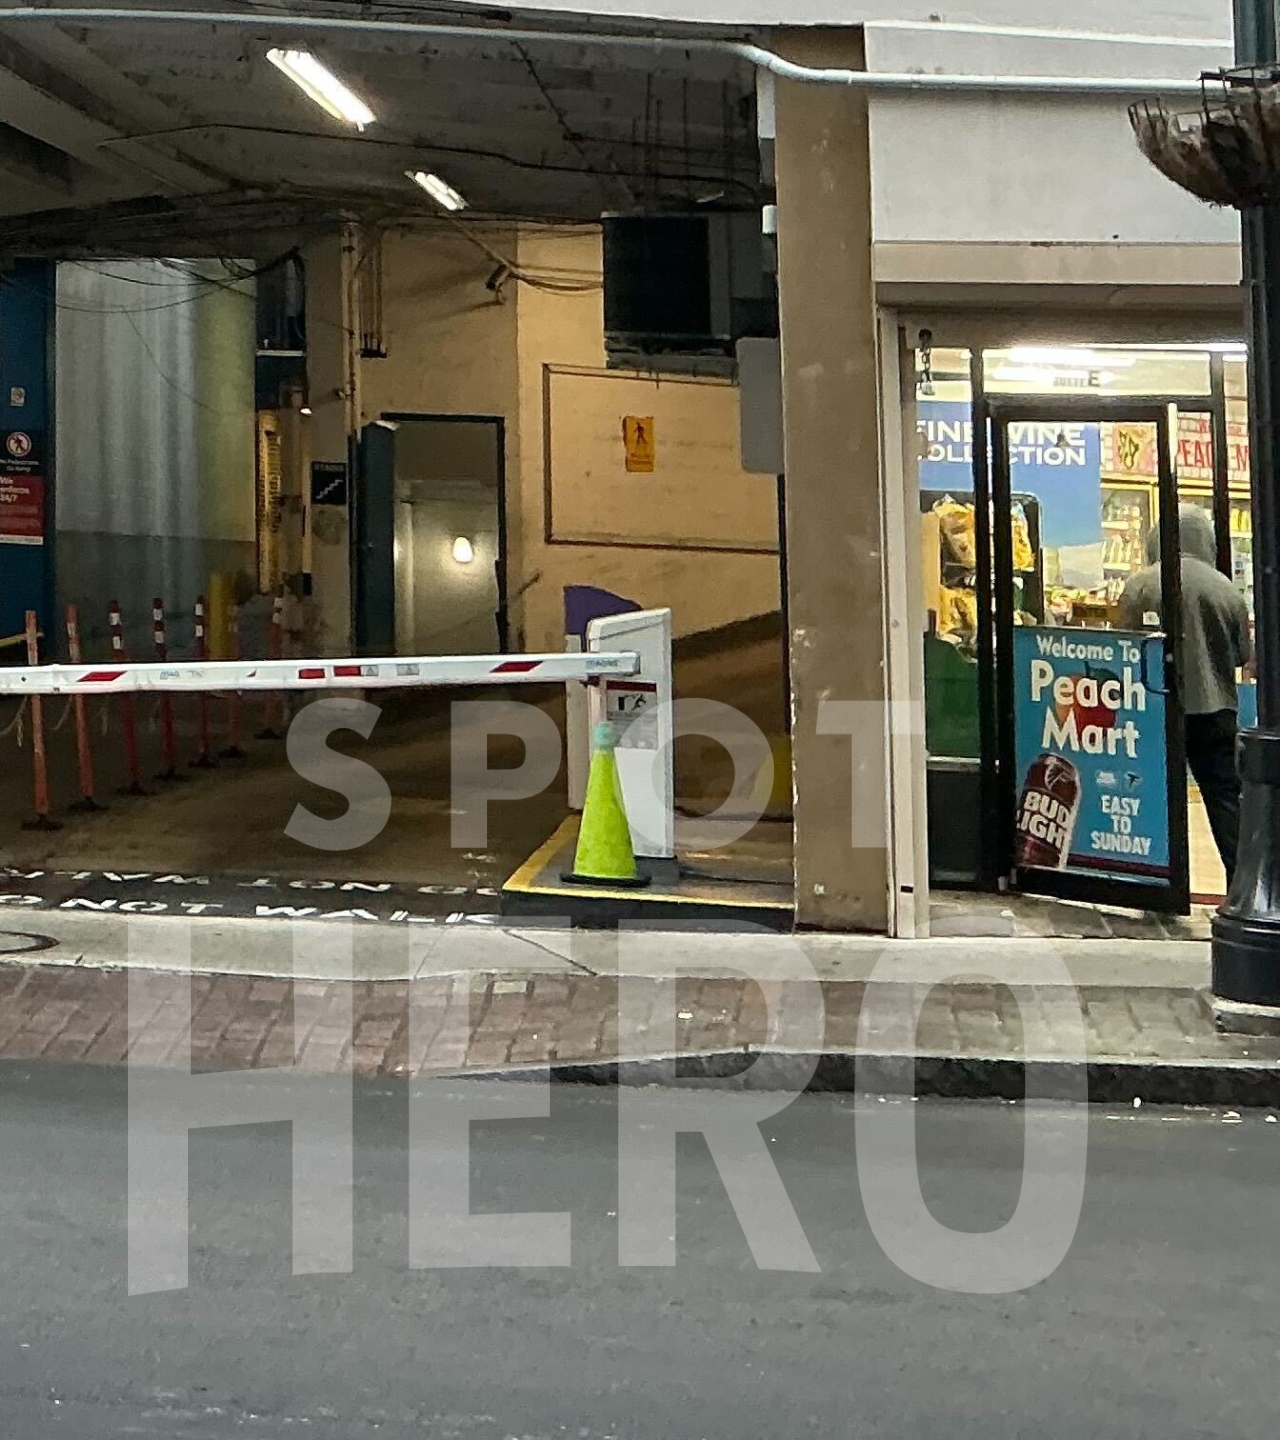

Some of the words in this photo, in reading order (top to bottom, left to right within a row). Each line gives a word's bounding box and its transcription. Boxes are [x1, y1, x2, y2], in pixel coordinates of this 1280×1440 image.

[1088, 370, 1101, 388] E
[917, 444, 1085, 466] OLLTION
[1036, 634, 1113, 661] Welcome
[1118, 640, 1140, 663] To
[1031, 660, 1146, 711] Peach
[1042, 707, 1140, 758] Mart
[1023, 791, 1072, 829] BUD
[1101, 795, 1140, 816] EASY
[1016, 809, 1064, 850] IGH
[1111, 815, 1131, 835] TO
[1091, 831, 1152, 856] SUNDAY
[59, 898, 224, 914] NOT
[255, 905, 500, 925] WALK
